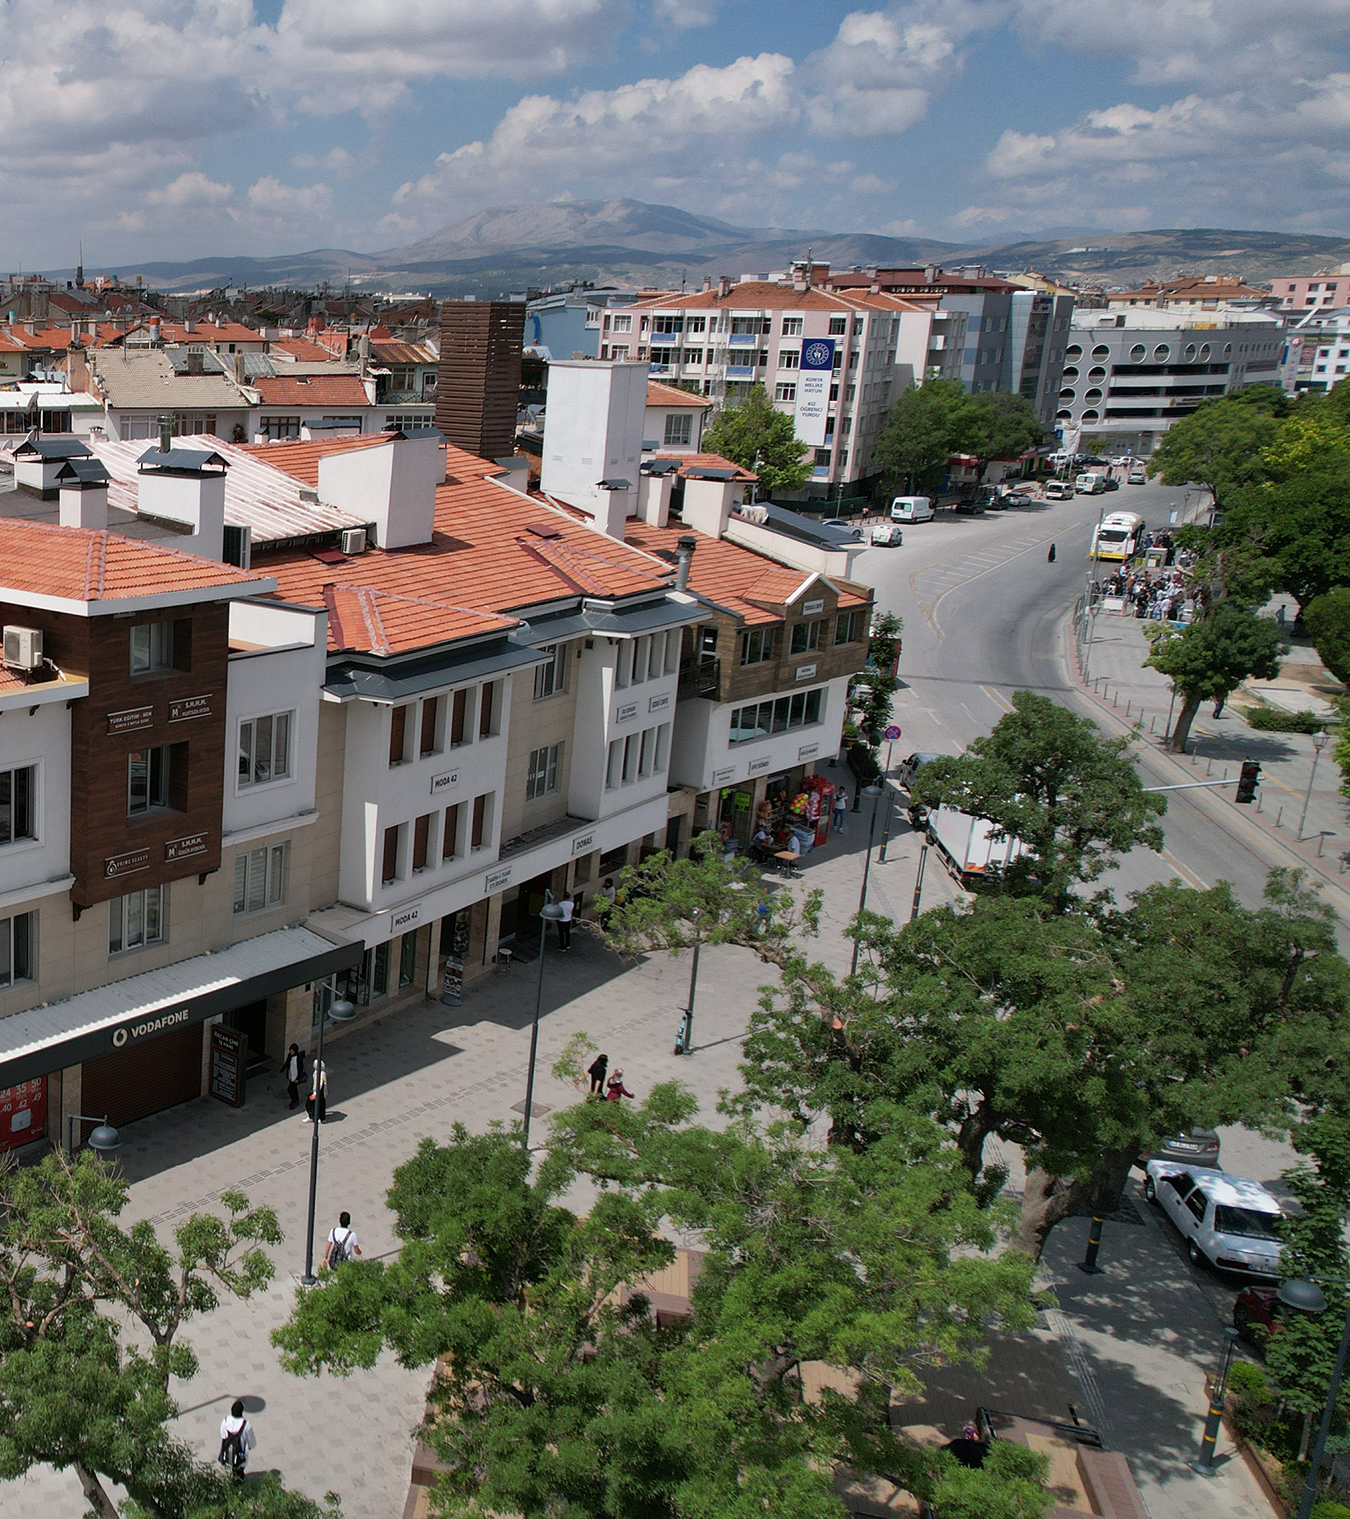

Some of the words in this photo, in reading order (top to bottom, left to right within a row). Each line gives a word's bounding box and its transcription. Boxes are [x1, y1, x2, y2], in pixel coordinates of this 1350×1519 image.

[123, 713, 140, 722] EĞİTİM
[435, 776, 450, 788] MODA
[450, 774, 458, 782] 42
[395, 913, 410, 926] MODA
[411, 910, 418, 919] 42
[130, 1009, 189, 1039] VODAFONE
[0, 1087, 11, 1099] 24
[15, 1082, 27, 1095] 35
[31, 1077, 42, 1088] 50
